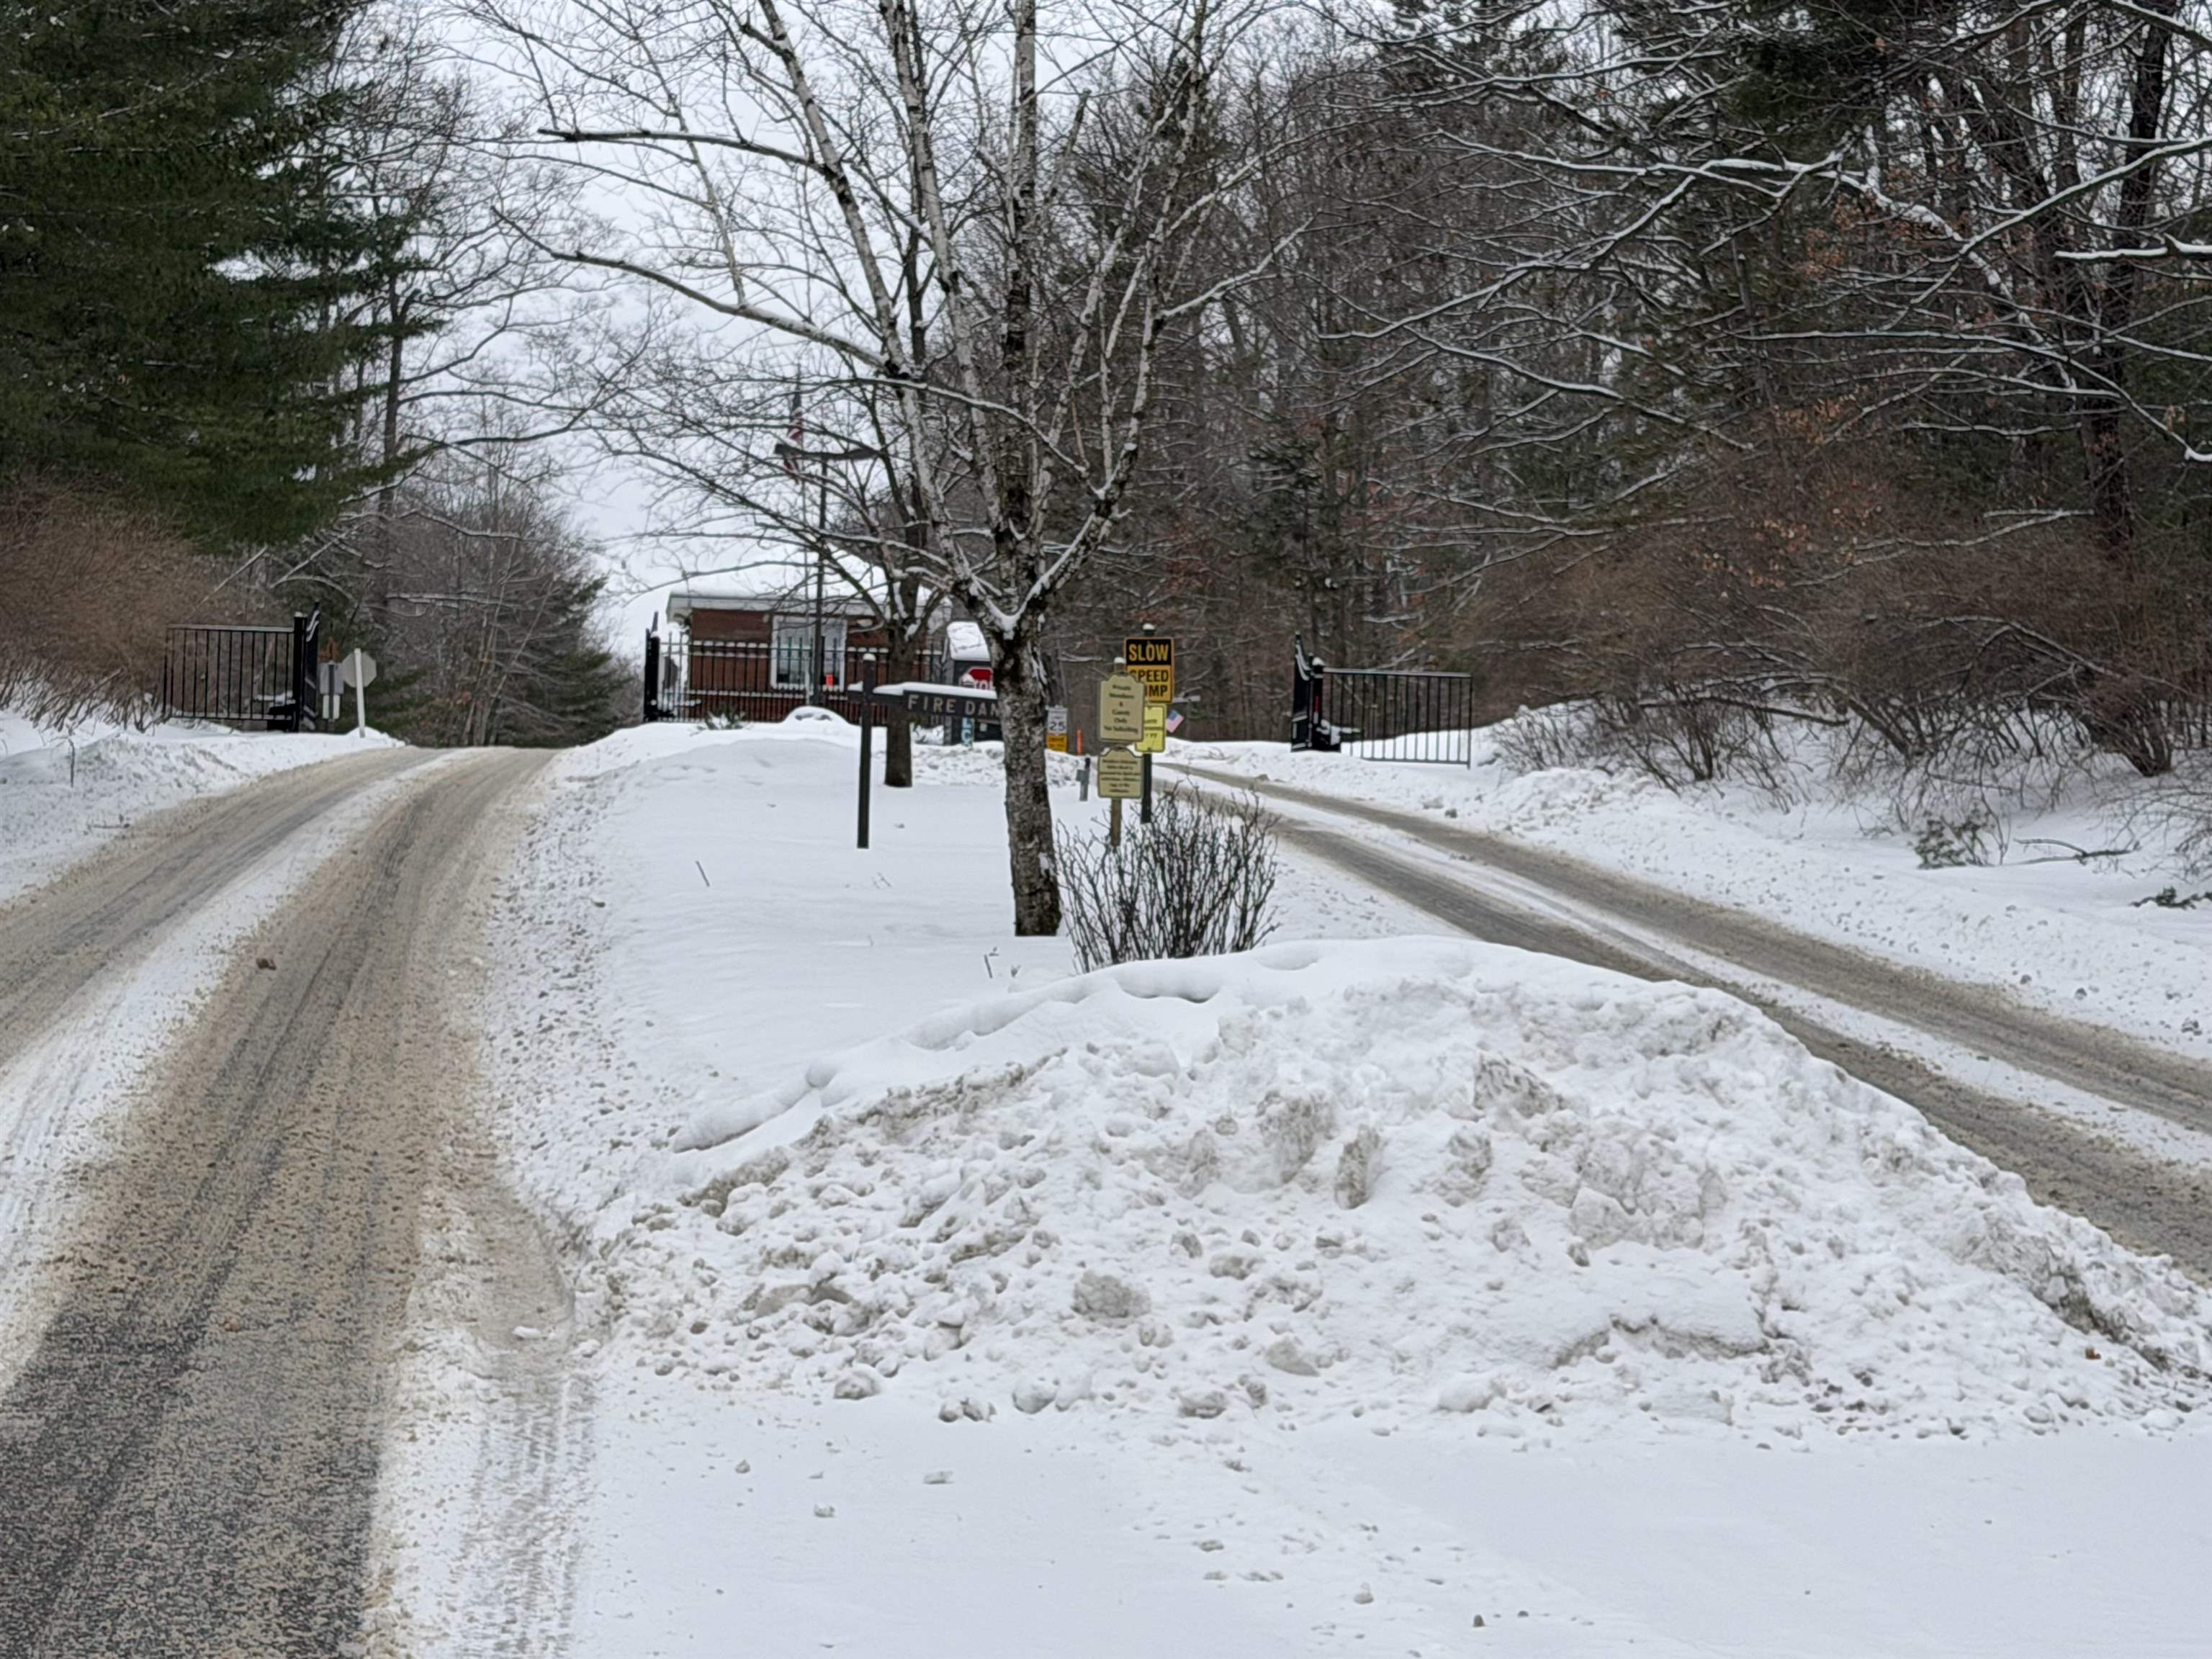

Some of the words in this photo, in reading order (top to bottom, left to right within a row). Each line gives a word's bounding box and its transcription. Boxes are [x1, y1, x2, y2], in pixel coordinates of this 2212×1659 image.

[1129, 644, 1169, 662] SLOW
[1145, 685, 1168, 697] MP
[907, 694, 956, 714] FIRE
[1050, 721, 1066, 731] 25
